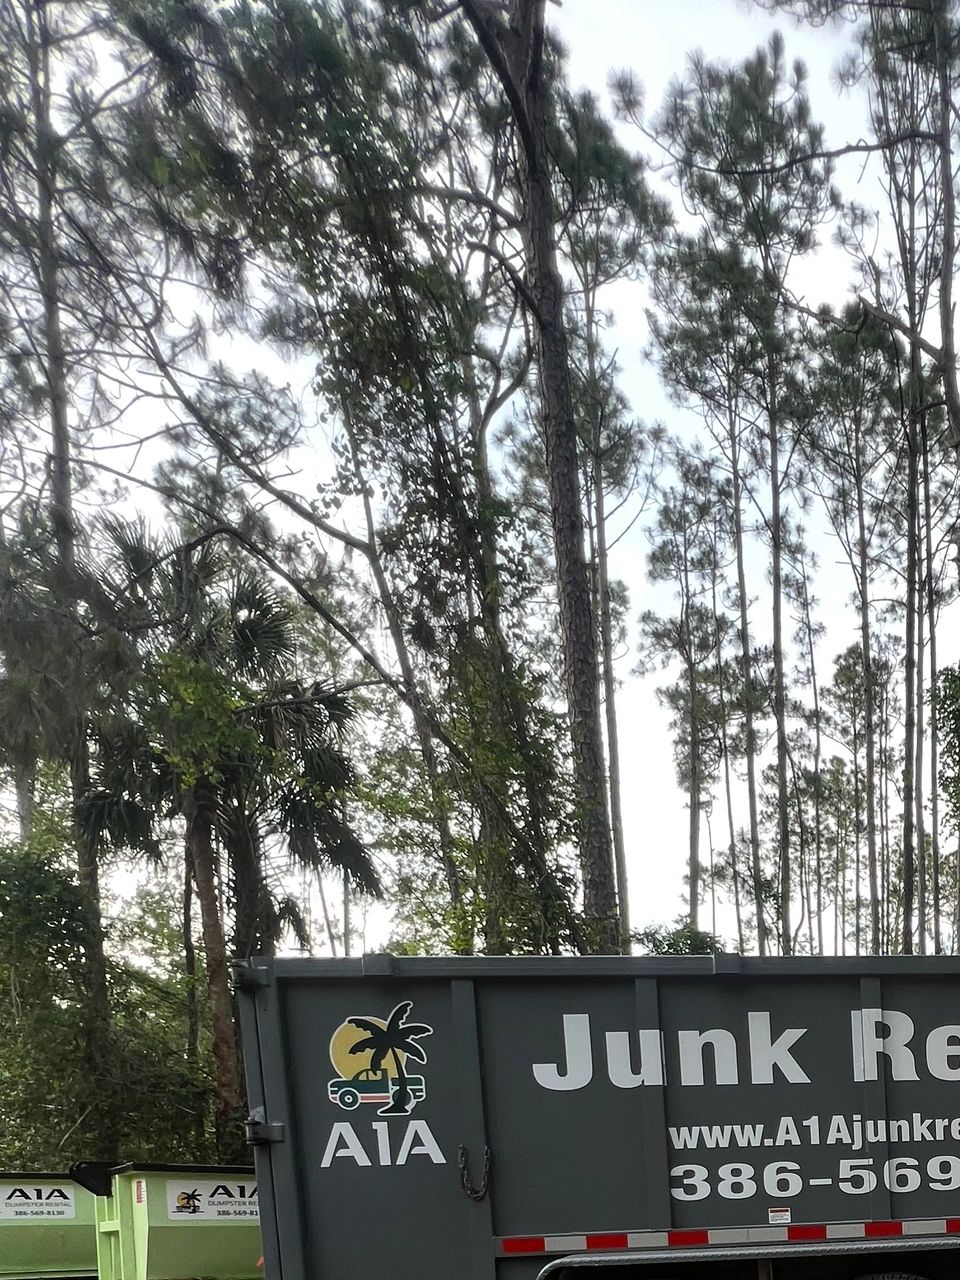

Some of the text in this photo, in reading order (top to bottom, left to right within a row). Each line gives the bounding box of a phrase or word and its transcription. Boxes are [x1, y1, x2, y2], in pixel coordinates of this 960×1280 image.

[533, 1012, 812, 1090] Junk
[321, 1120, 447, 1167] A1A
[6, 1188, 70, 1200] A1A
[216, 1209, 259, 1217] 386-569-81
